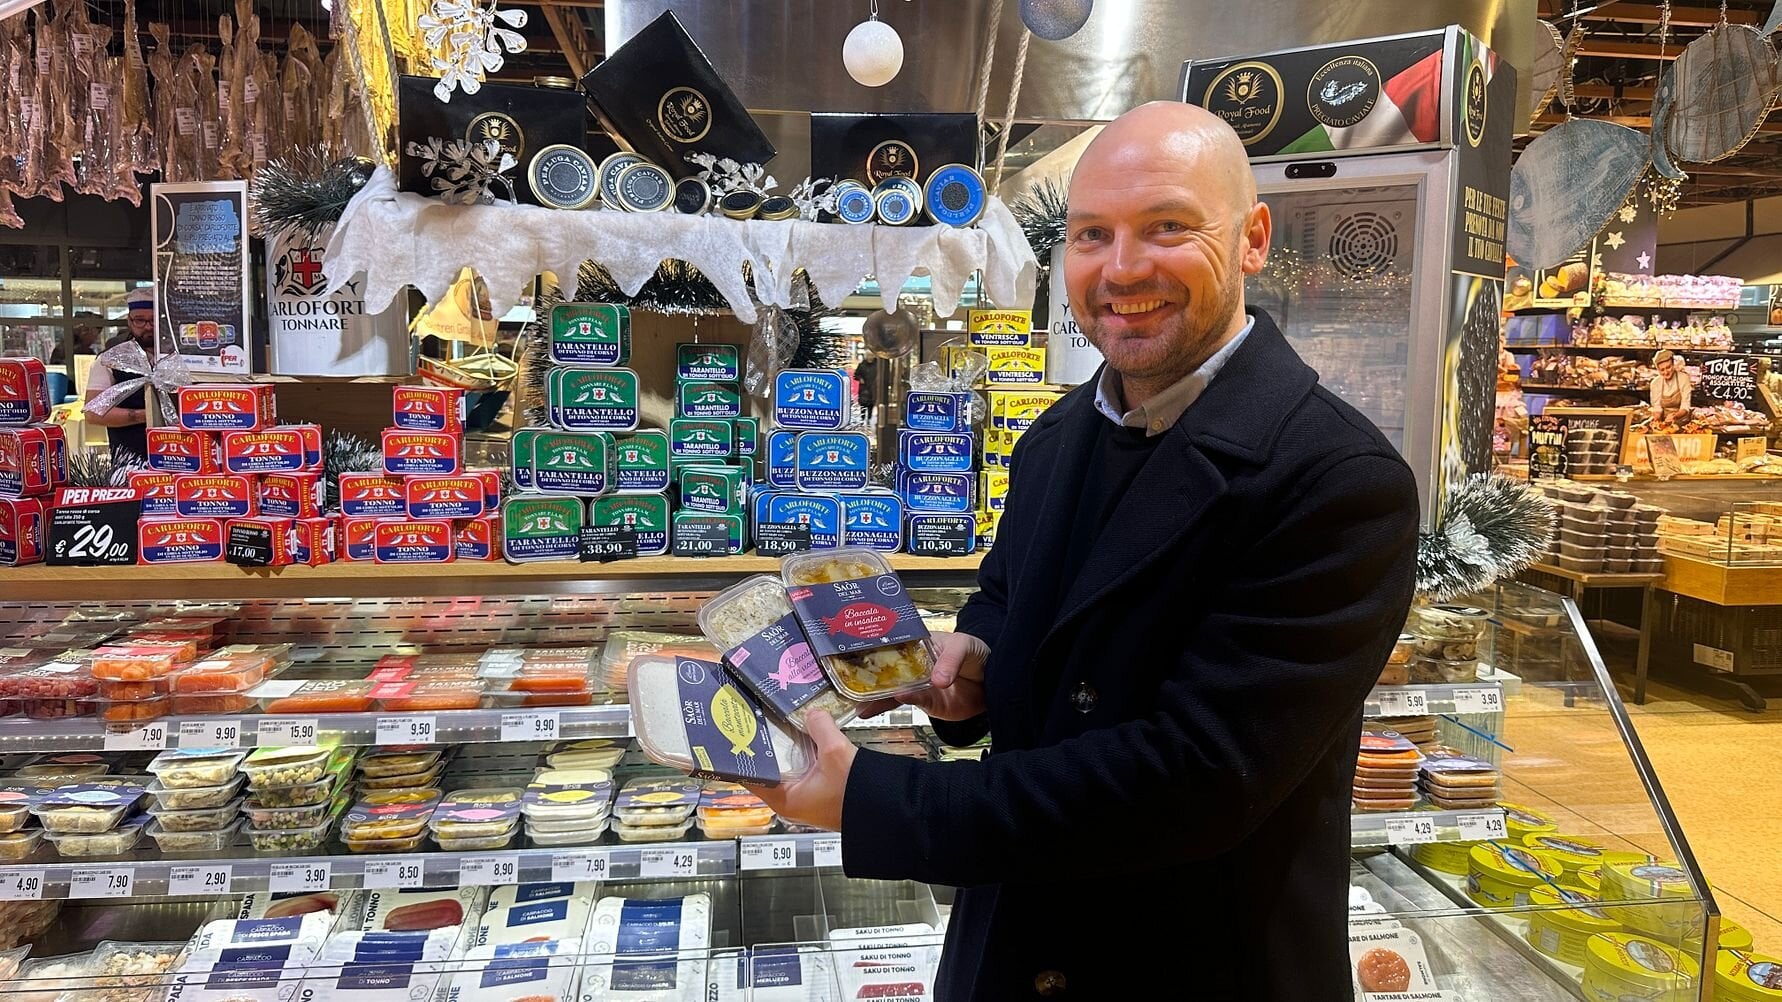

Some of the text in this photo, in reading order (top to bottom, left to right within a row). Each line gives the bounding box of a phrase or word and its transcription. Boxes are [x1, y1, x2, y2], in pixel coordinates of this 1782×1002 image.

[1316, 60, 1373, 81] Eccellenza italiana
[1215, 105, 1271, 121] Royal Food
[1312, 98, 1375, 126] PREGIATO CAVIALE
[572, 159, 588, 192] CAVIAR
[281, 319, 348, 331] TONNARE
[974, 314, 1027, 325] CARLOFORTE
[555, 343, 617, 351] TARANTELLO
[991, 351, 1041, 362] CARLOFORTE
[784, 375, 834, 390] CARLOFORTE
[186, 391, 248, 402] CARLOFORTE
[398, 391, 440, 404] CARLOFORTE
[912, 395, 950, 404] CARLOFORTE
[564, 408, 634, 416] TARANTELLO
[778, 408, 840, 417] BUZZONAGLIA
[232, 433, 295, 445] CARLOFORTE
[389, 435, 449, 447] CARLOFORTE
[807, 437, 859, 452] CARLOFORTE
[914, 436, 966, 445] CARLOFORTE
[537, 471, 603, 481] TARANTELLO
[800, 470, 866, 478] BUZZONAGLIA
[913, 476, 962, 485] CARLOFORTE
[181, 478, 242, 490] CARLOFORTE
[413, 480, 475, 491] CARLOFORTE
[62, 489, 136, 505] IPER PREZZO
[691, 496, 720, 505] TARANTELLO
[914, 495, 961, 503] BUZZONAGLIA
[779, 501, 830, 515] CARLOFORTE
[147, 523, 214, 536] CARLOFORTE
[381, 524, 443, 535] CARLOFORTE
[508, 537, 579, 546] TARANTELLO
[854, 615, 888, 627] insalata
[1407, 695, 1424, 708] 5,90
[1482, 693, 1498, 706] 3,90
[290, 725, 314, 739] 15,90
[410, 723, 431, 736] 9,50
[535, 719, 555, 732] 9,90
[142, 728, 163, 742] 7,90
[215, 727, 236, 740] 9,90
[1415, 822, 1432, 834] 4,29
[1486, 819, 1503, 832] 4,29
[773, 847, 792, 860] 6,90
[586, 859, 605, 872] 7,90
[673, 855, 693, 868] 4,29
[305, 869, 326, 883] 3,90
[399, 866, 419, 880] 8,50
[494, 863, 514, 877] 8,90
[16, 877, 39, 892] 4,90
[108, 875, 129, 889] 7,90
[205, 872, 227, 886] 2,90
[240, 893, 255, 920] SPADA
[366, 893, 381, 923] TONNO
[523, 909, 553, 917] CARPACCIO
[503, 972, 533, 981] SALMONE
[168, 976, 188, 1002] PADA
[1373, 993, 1401, 1001] TARTARE
